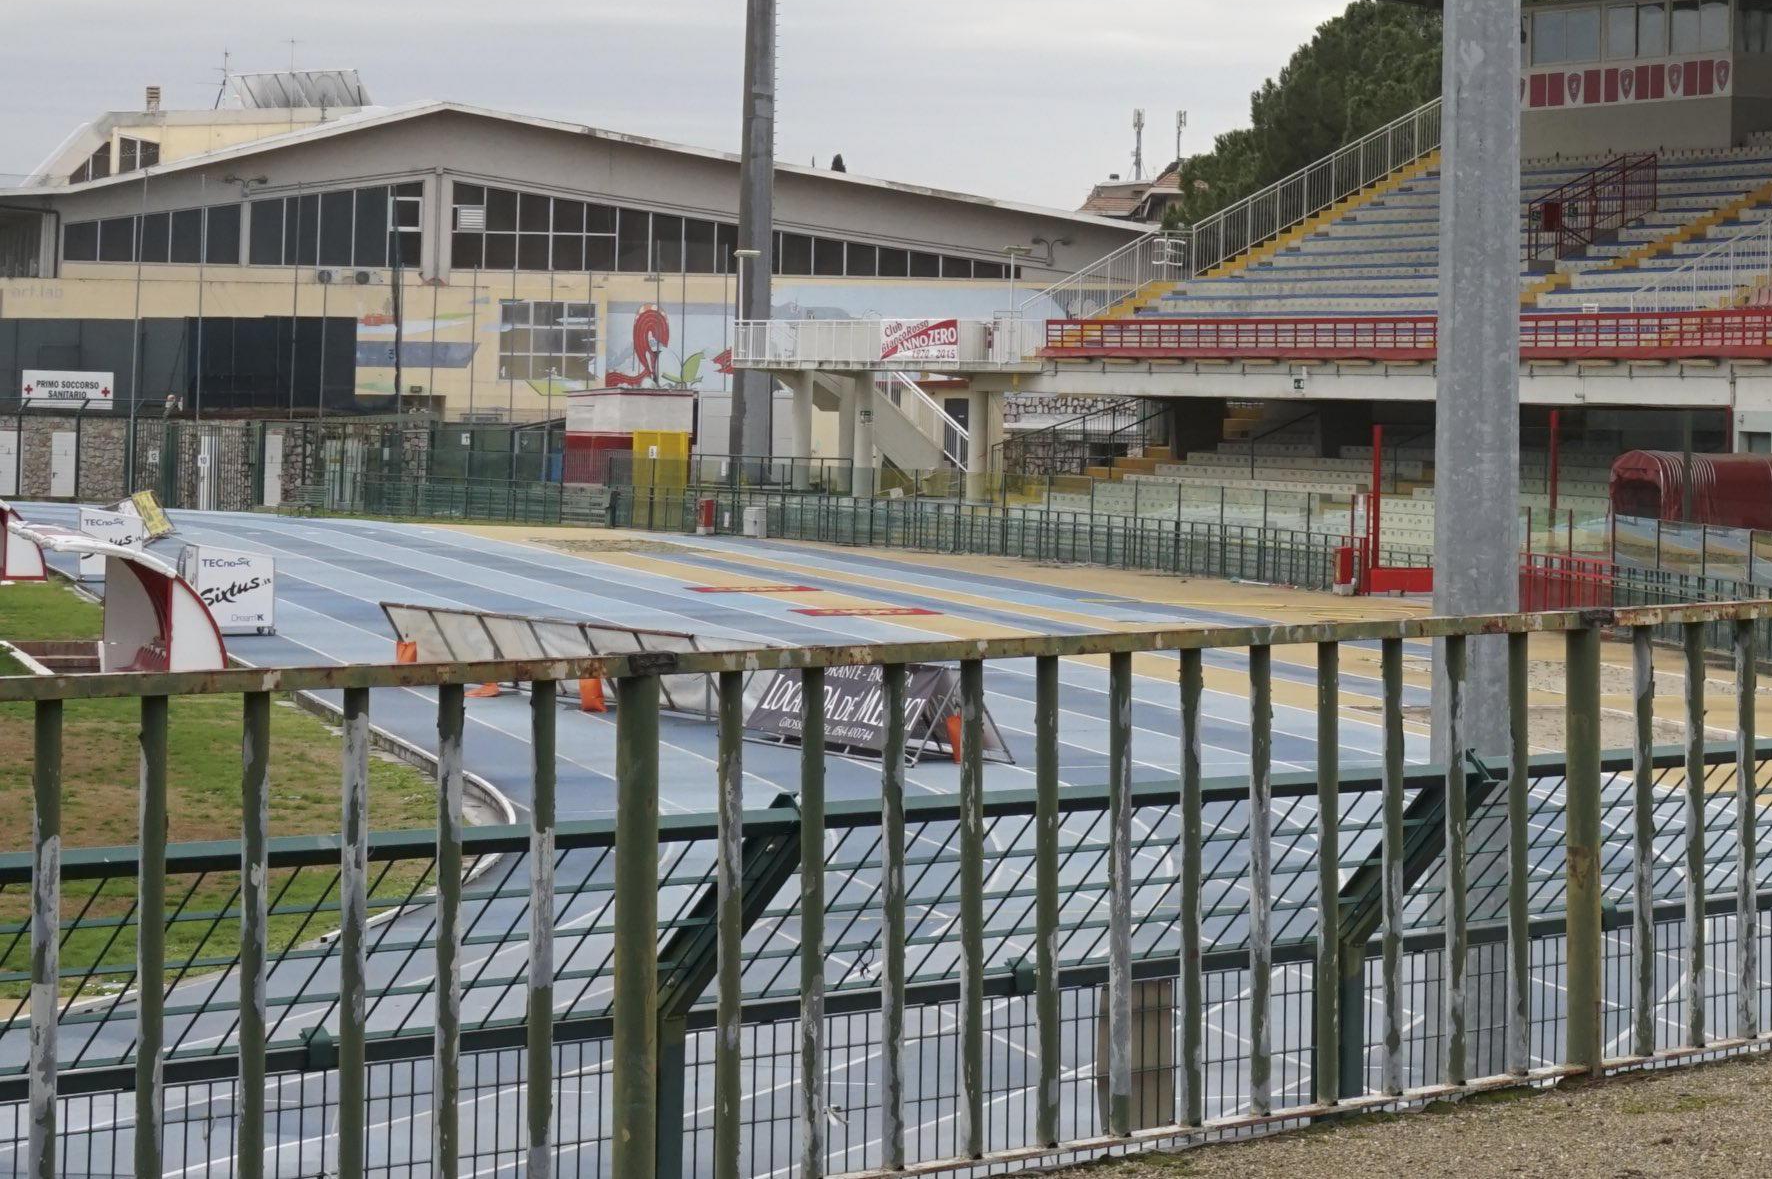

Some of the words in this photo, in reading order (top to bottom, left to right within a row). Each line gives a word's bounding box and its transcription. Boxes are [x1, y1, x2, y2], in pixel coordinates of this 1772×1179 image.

[884, 321, 903, 338] Club
[898, 335, 929, 353] ANNO
[928, 327, 957, 346] ZERO
[36, 380, 59, 389] PRIMO
[61, 381, 99, 390] SOCCORSO
[48, 390, 87, 399] SANITARIO
